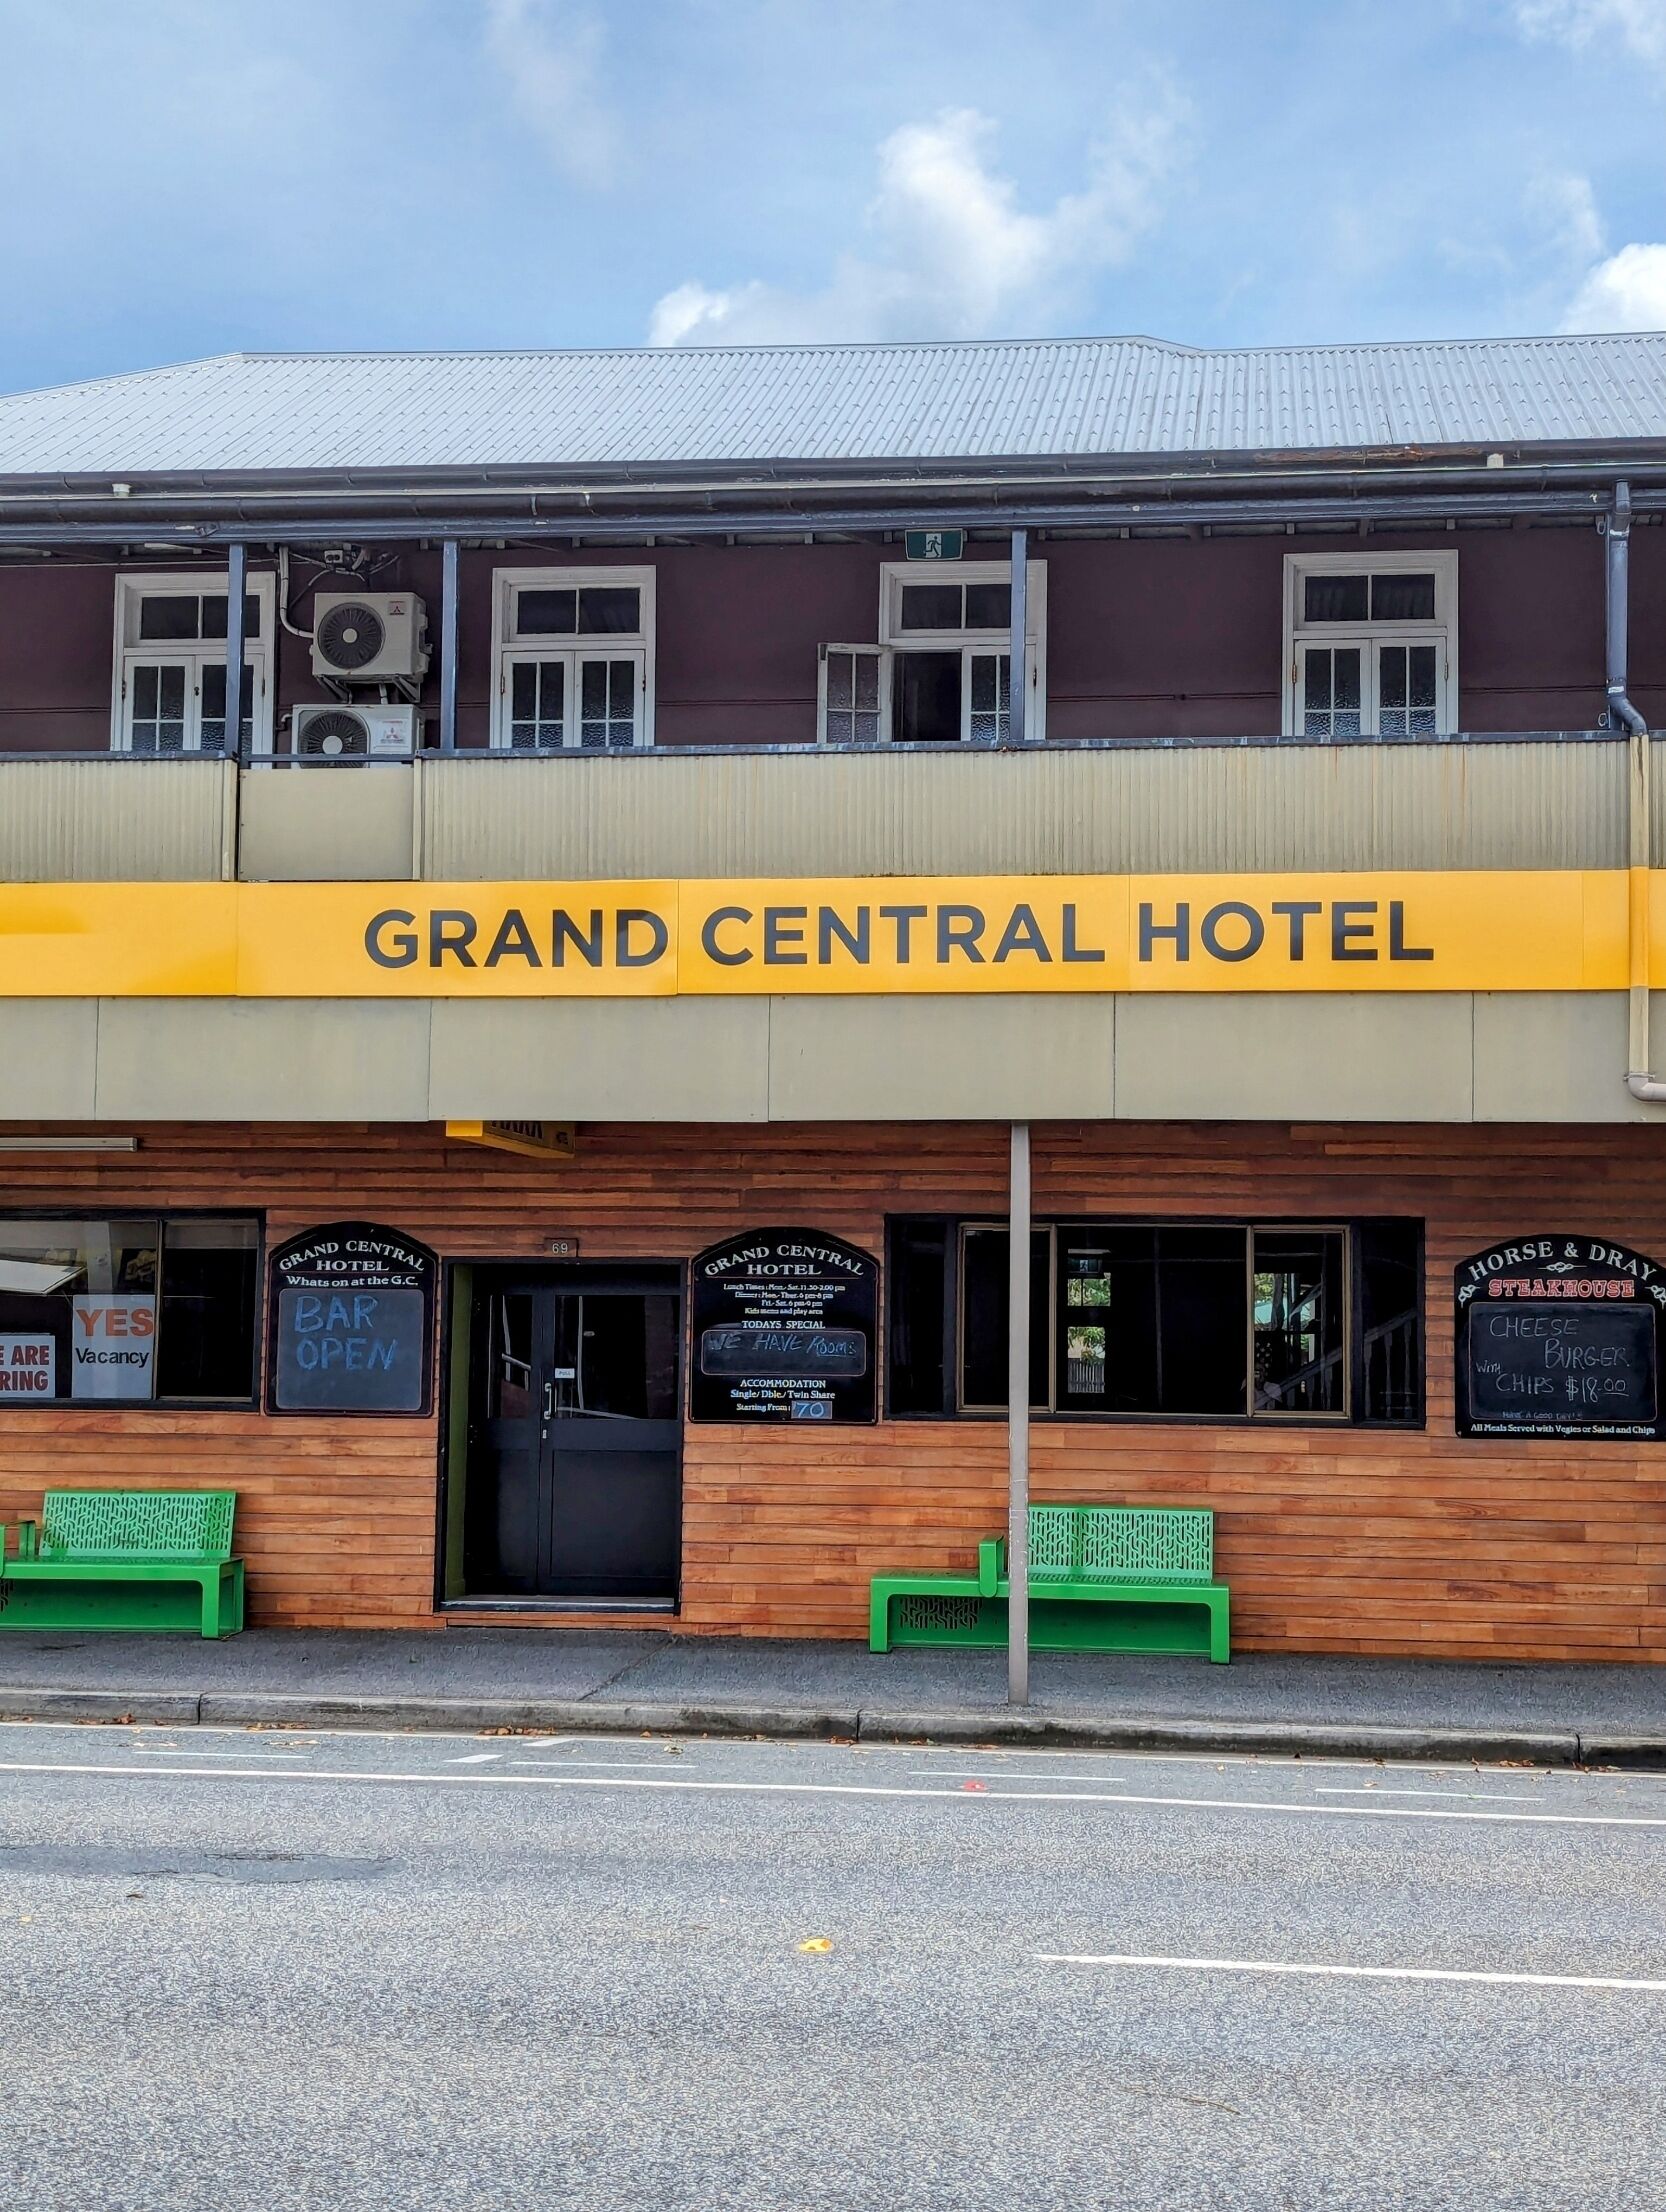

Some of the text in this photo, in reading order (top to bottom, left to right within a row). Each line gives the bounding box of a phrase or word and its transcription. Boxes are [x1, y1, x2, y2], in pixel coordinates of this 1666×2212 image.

[364, 900, 1435, 969] GRAND CENTRAL HOTEL
[279, 1240, 425, 1271] GRAND CENTRAL
[552, 1243, 568, 1254] 69
[316, 1260, 389, 1271] HOTEL
[705, 1244, 864, 1276] GRAND CENTRAL
[747, 1264, 822, 1275] HOTEL
[1468, 1241, 1657, 1281] HORSE & DRAY
[286, 1275, 419, 1287] Whats on at the G.C.
[1488, 1279, 1635, 1298] STEAKHOUSE
[76, 1309, 154, 1336] YES
[294, 1295, 379, 1333] BAR
[742, 1320, 825, 1329] TODAYS SPECIAL
[1490, 1315, 1579, 1338] CHEESE
[752, 1332, 802, 1351] HAVE
[11, 1345, 49, 1365] ARE
[75, 1347, 149, 1368] Vacancy
[296, 1338, 398, 1370] OPEN
[1544, 1338, 1630, 1370] BURGER
[740, 1379, 826, 1388] ACCOMMODATION
[1496, 1374, 1554, 1395] CHIPS
[788, 1390, 809, 1399] Twin
[810, 1391, 835, 1399] Share
[736, 1403, 766, 1412] Starting
[795, 1402, 825, 1418] 70
[1471, 1424, 1483, 1432] All
[1484, 1424, 1507, 1432] Meals
[1508, 1424, 1535, 1433] Served
[1536, 1424, 1553, 1433] with
[1592, 1424, 1614, 1433] Salad
[1616, 1426, 1631, 1434] and
[1632, 1426, 1656, 1435] Chips
